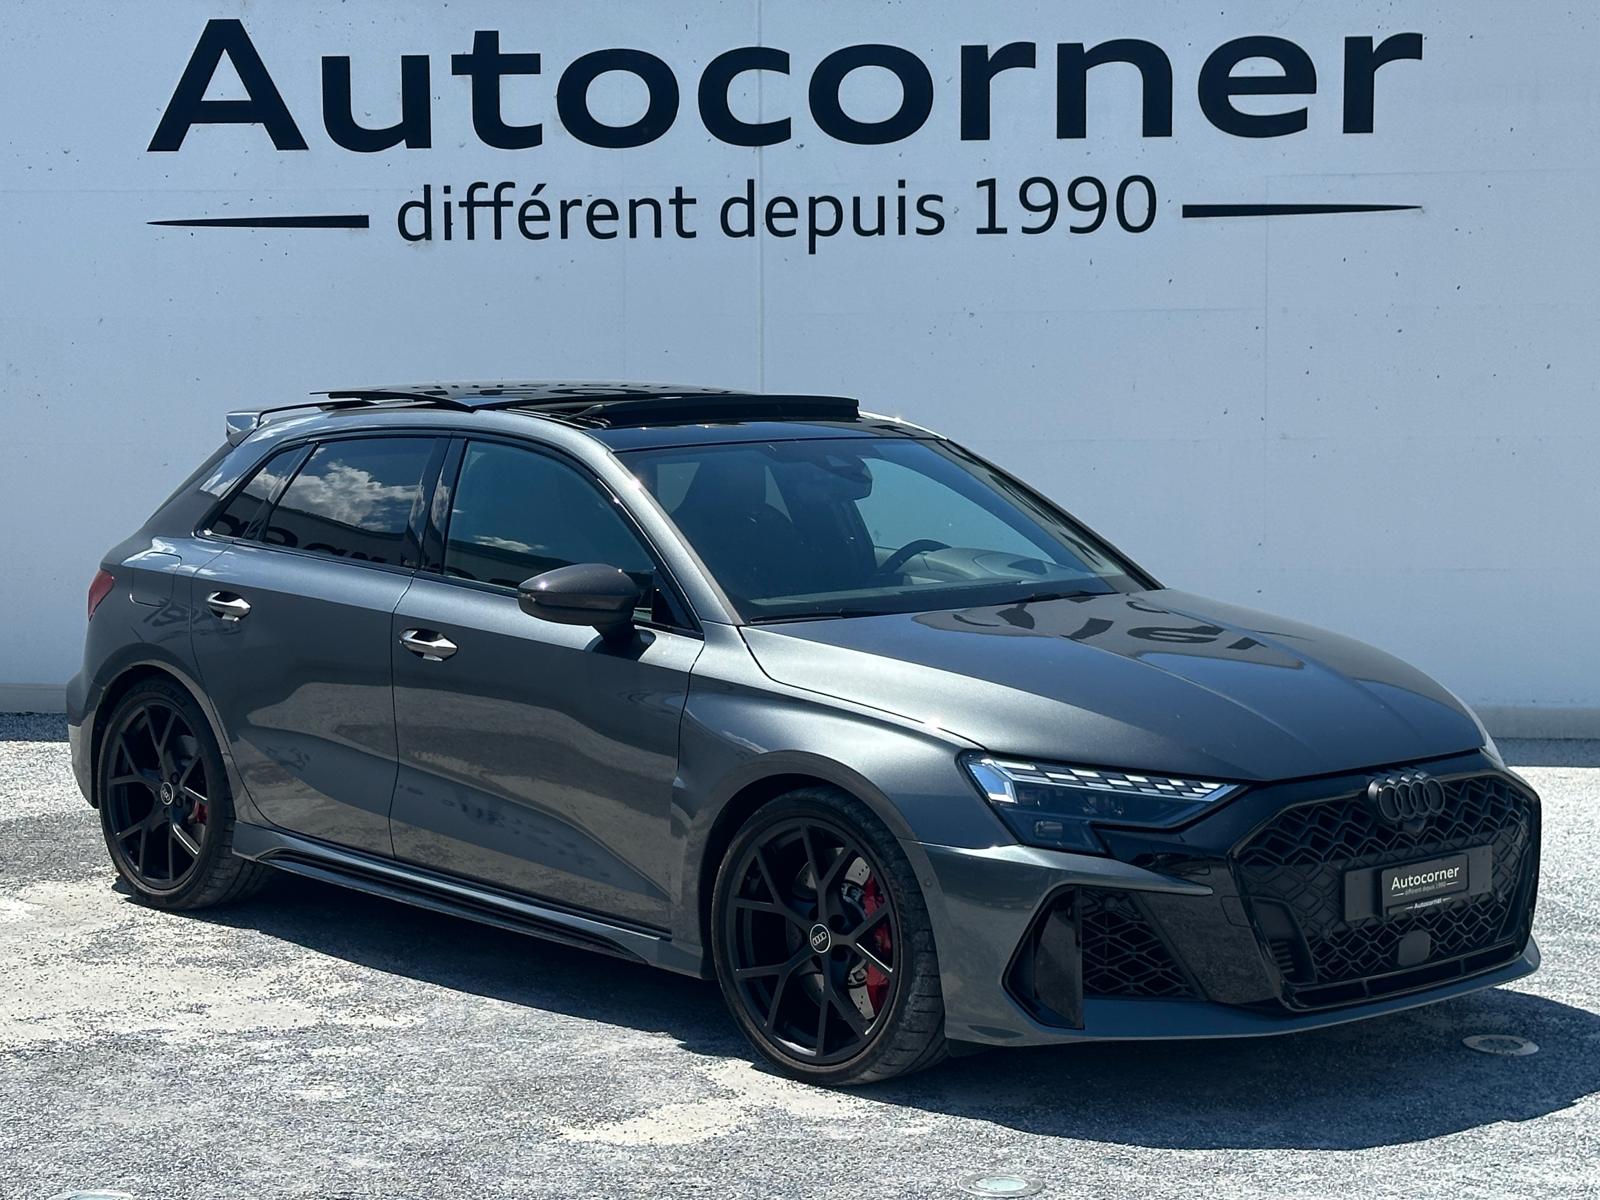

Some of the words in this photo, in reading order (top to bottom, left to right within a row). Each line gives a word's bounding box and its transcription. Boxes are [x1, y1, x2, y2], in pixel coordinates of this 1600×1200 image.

[147, 19, 1423, 154] Autocorner
[397, 181, 697, 242] différent
[719, 178, 946, 256] depuis
[976, 174, 1157, 235] 1990
[1391, 866, 1460, 891] Autocorner
